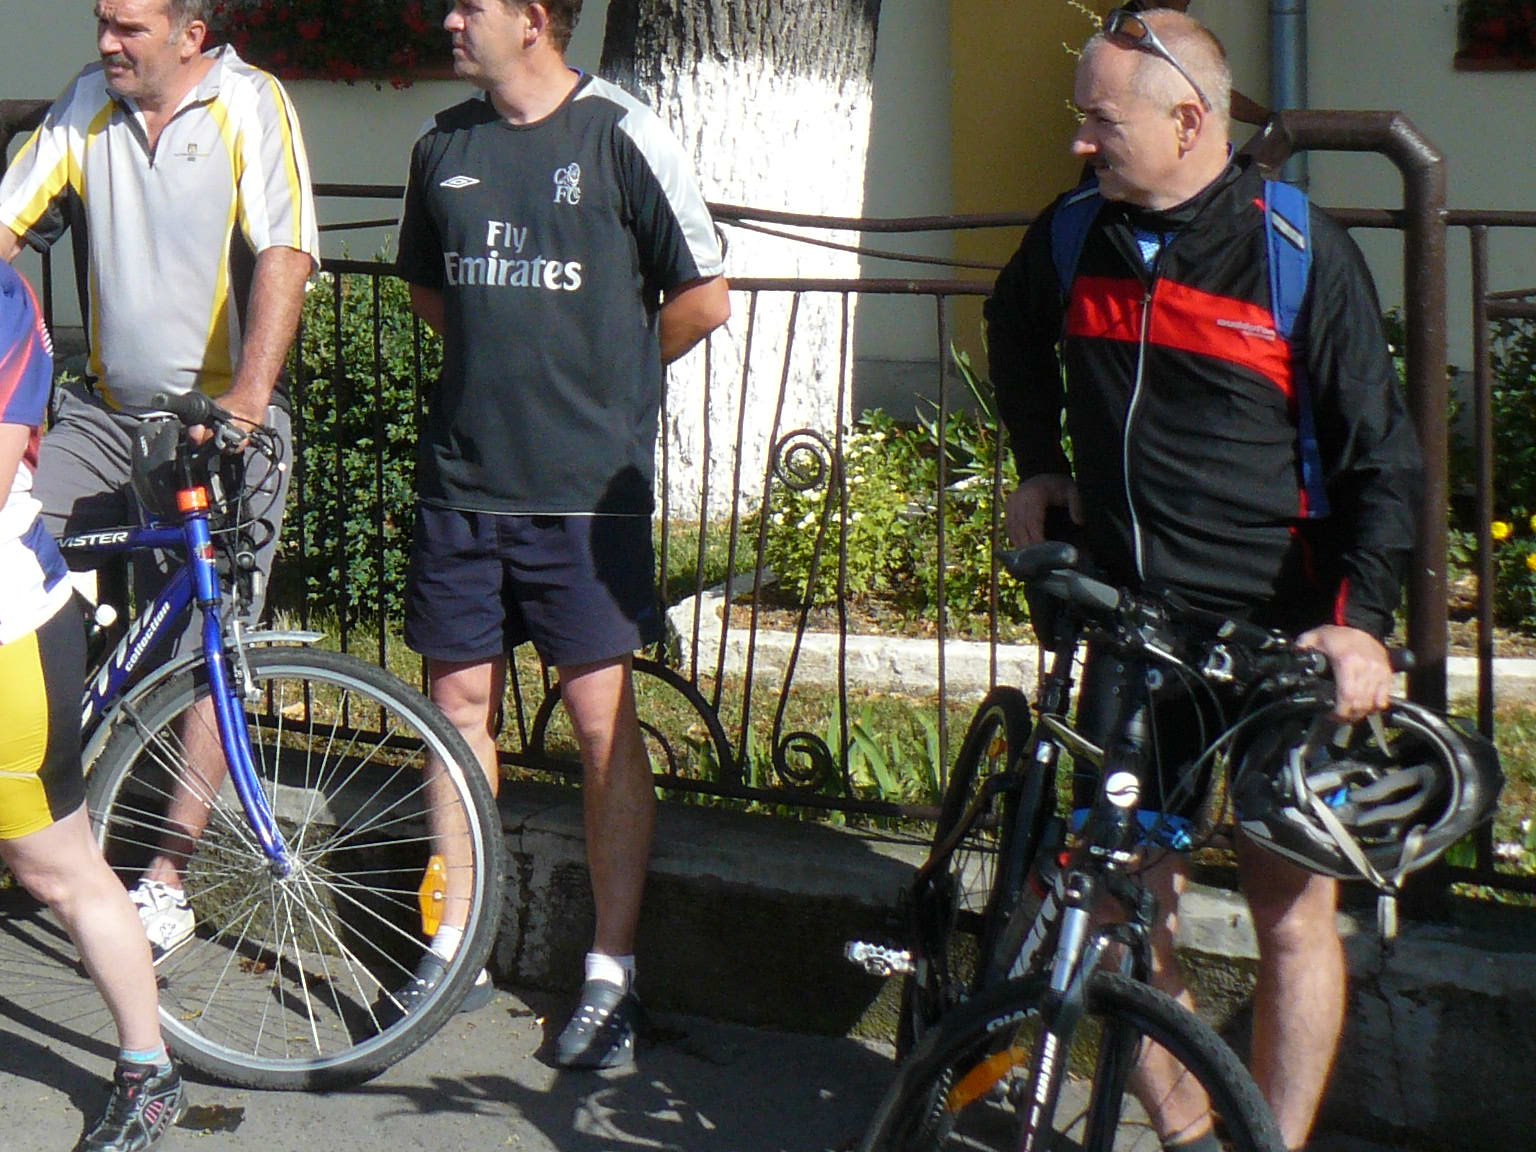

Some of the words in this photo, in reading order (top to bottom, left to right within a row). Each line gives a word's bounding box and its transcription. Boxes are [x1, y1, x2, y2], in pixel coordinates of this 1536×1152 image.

[486, 220, 527, 253] Fly
[444, 250, 582, 291] Emirates
[125, 601, 171, 672] collection
